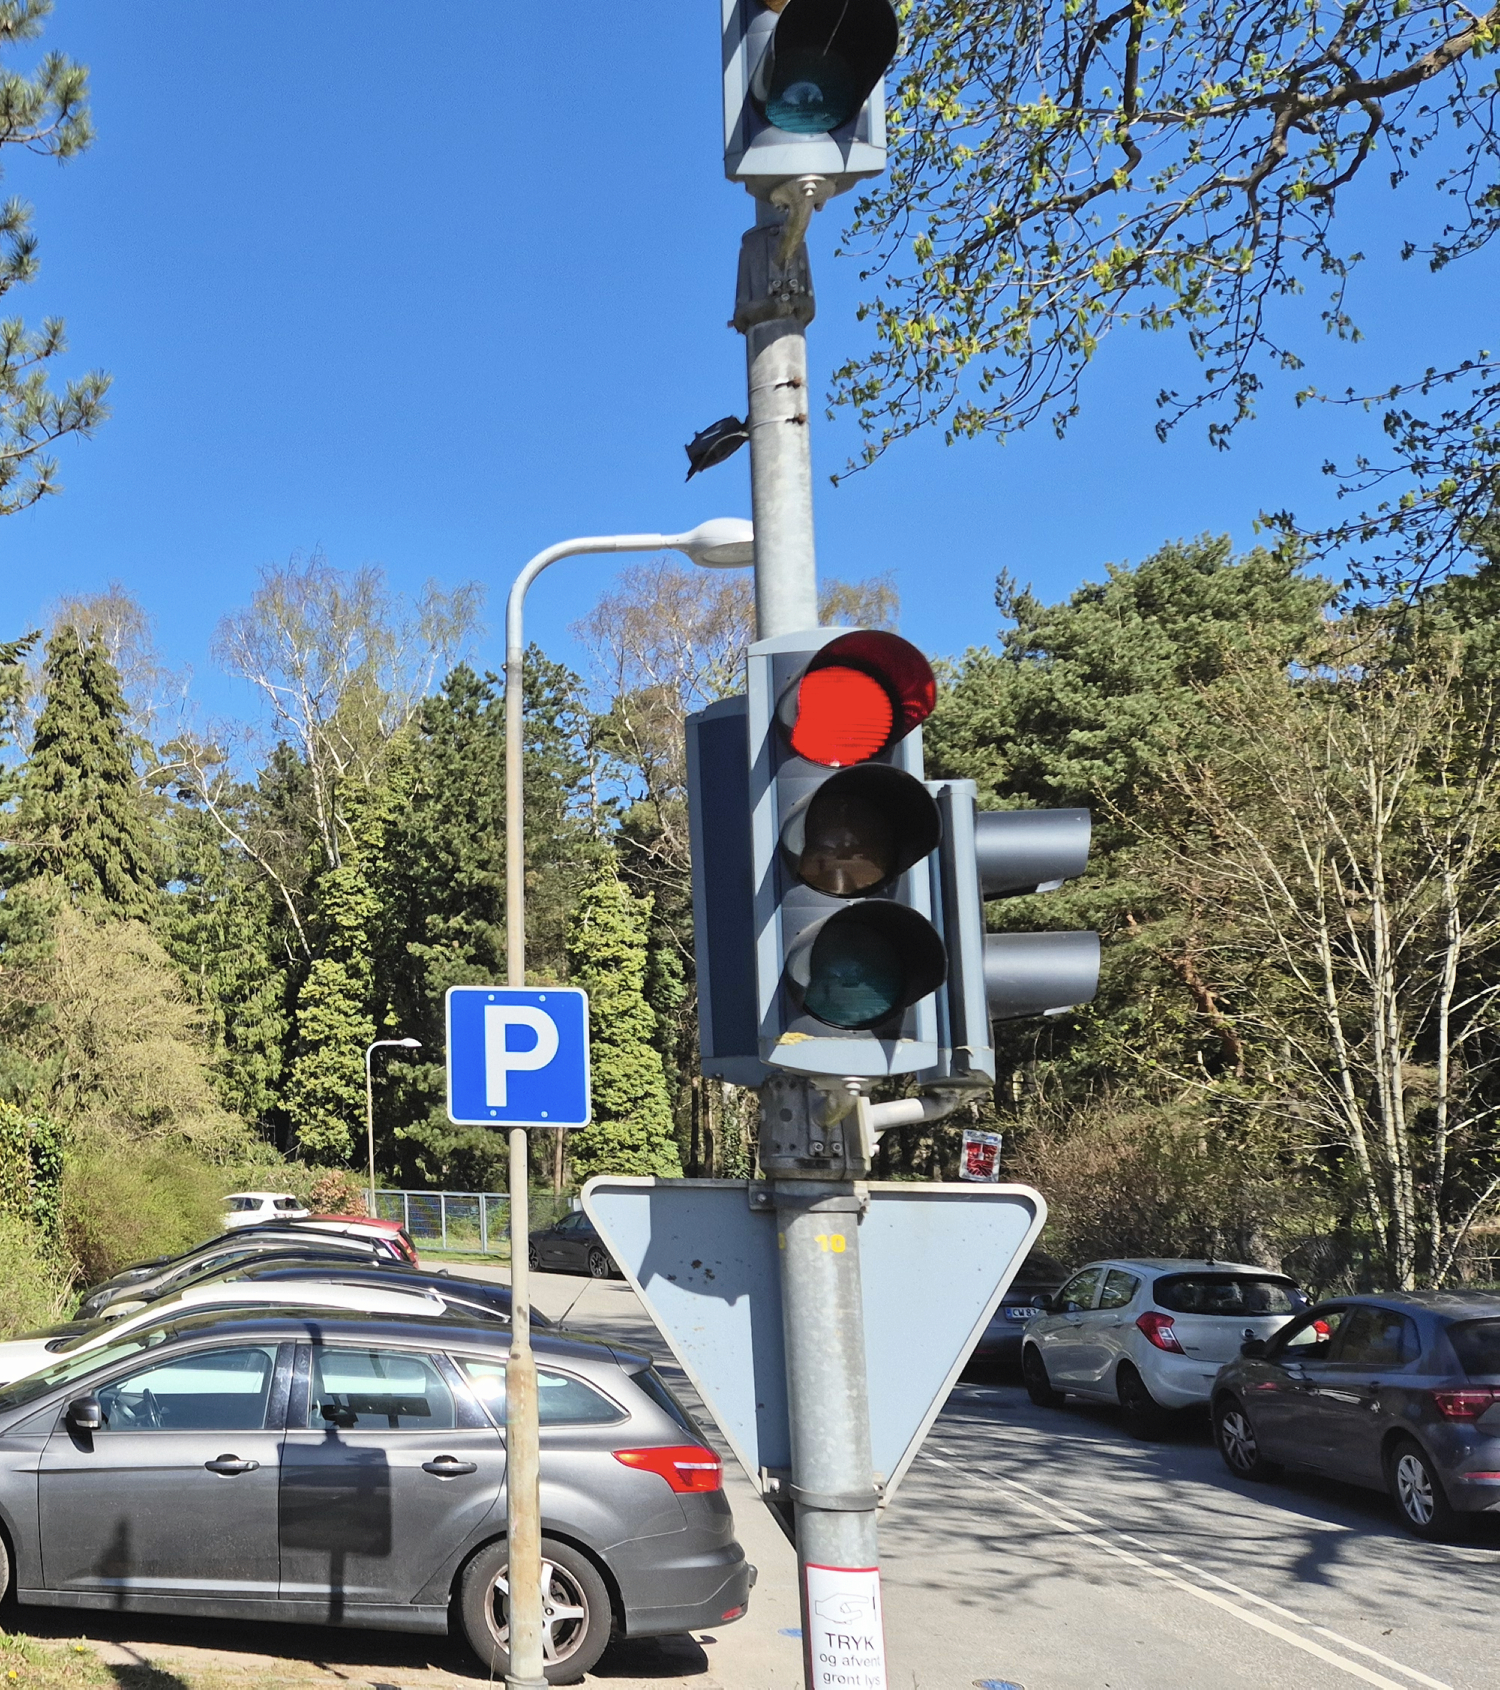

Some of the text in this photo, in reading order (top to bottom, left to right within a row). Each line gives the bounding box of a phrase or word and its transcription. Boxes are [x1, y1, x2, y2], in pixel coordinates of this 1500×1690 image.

[484, 1004, 560, 1107] P
[814, 1233, 846, 1253] 10
[824, 1632, 875, 1651] TRYK
[819, 1653, 881, 1668] og afvent
[864, 1674, 881, 1690] lys
